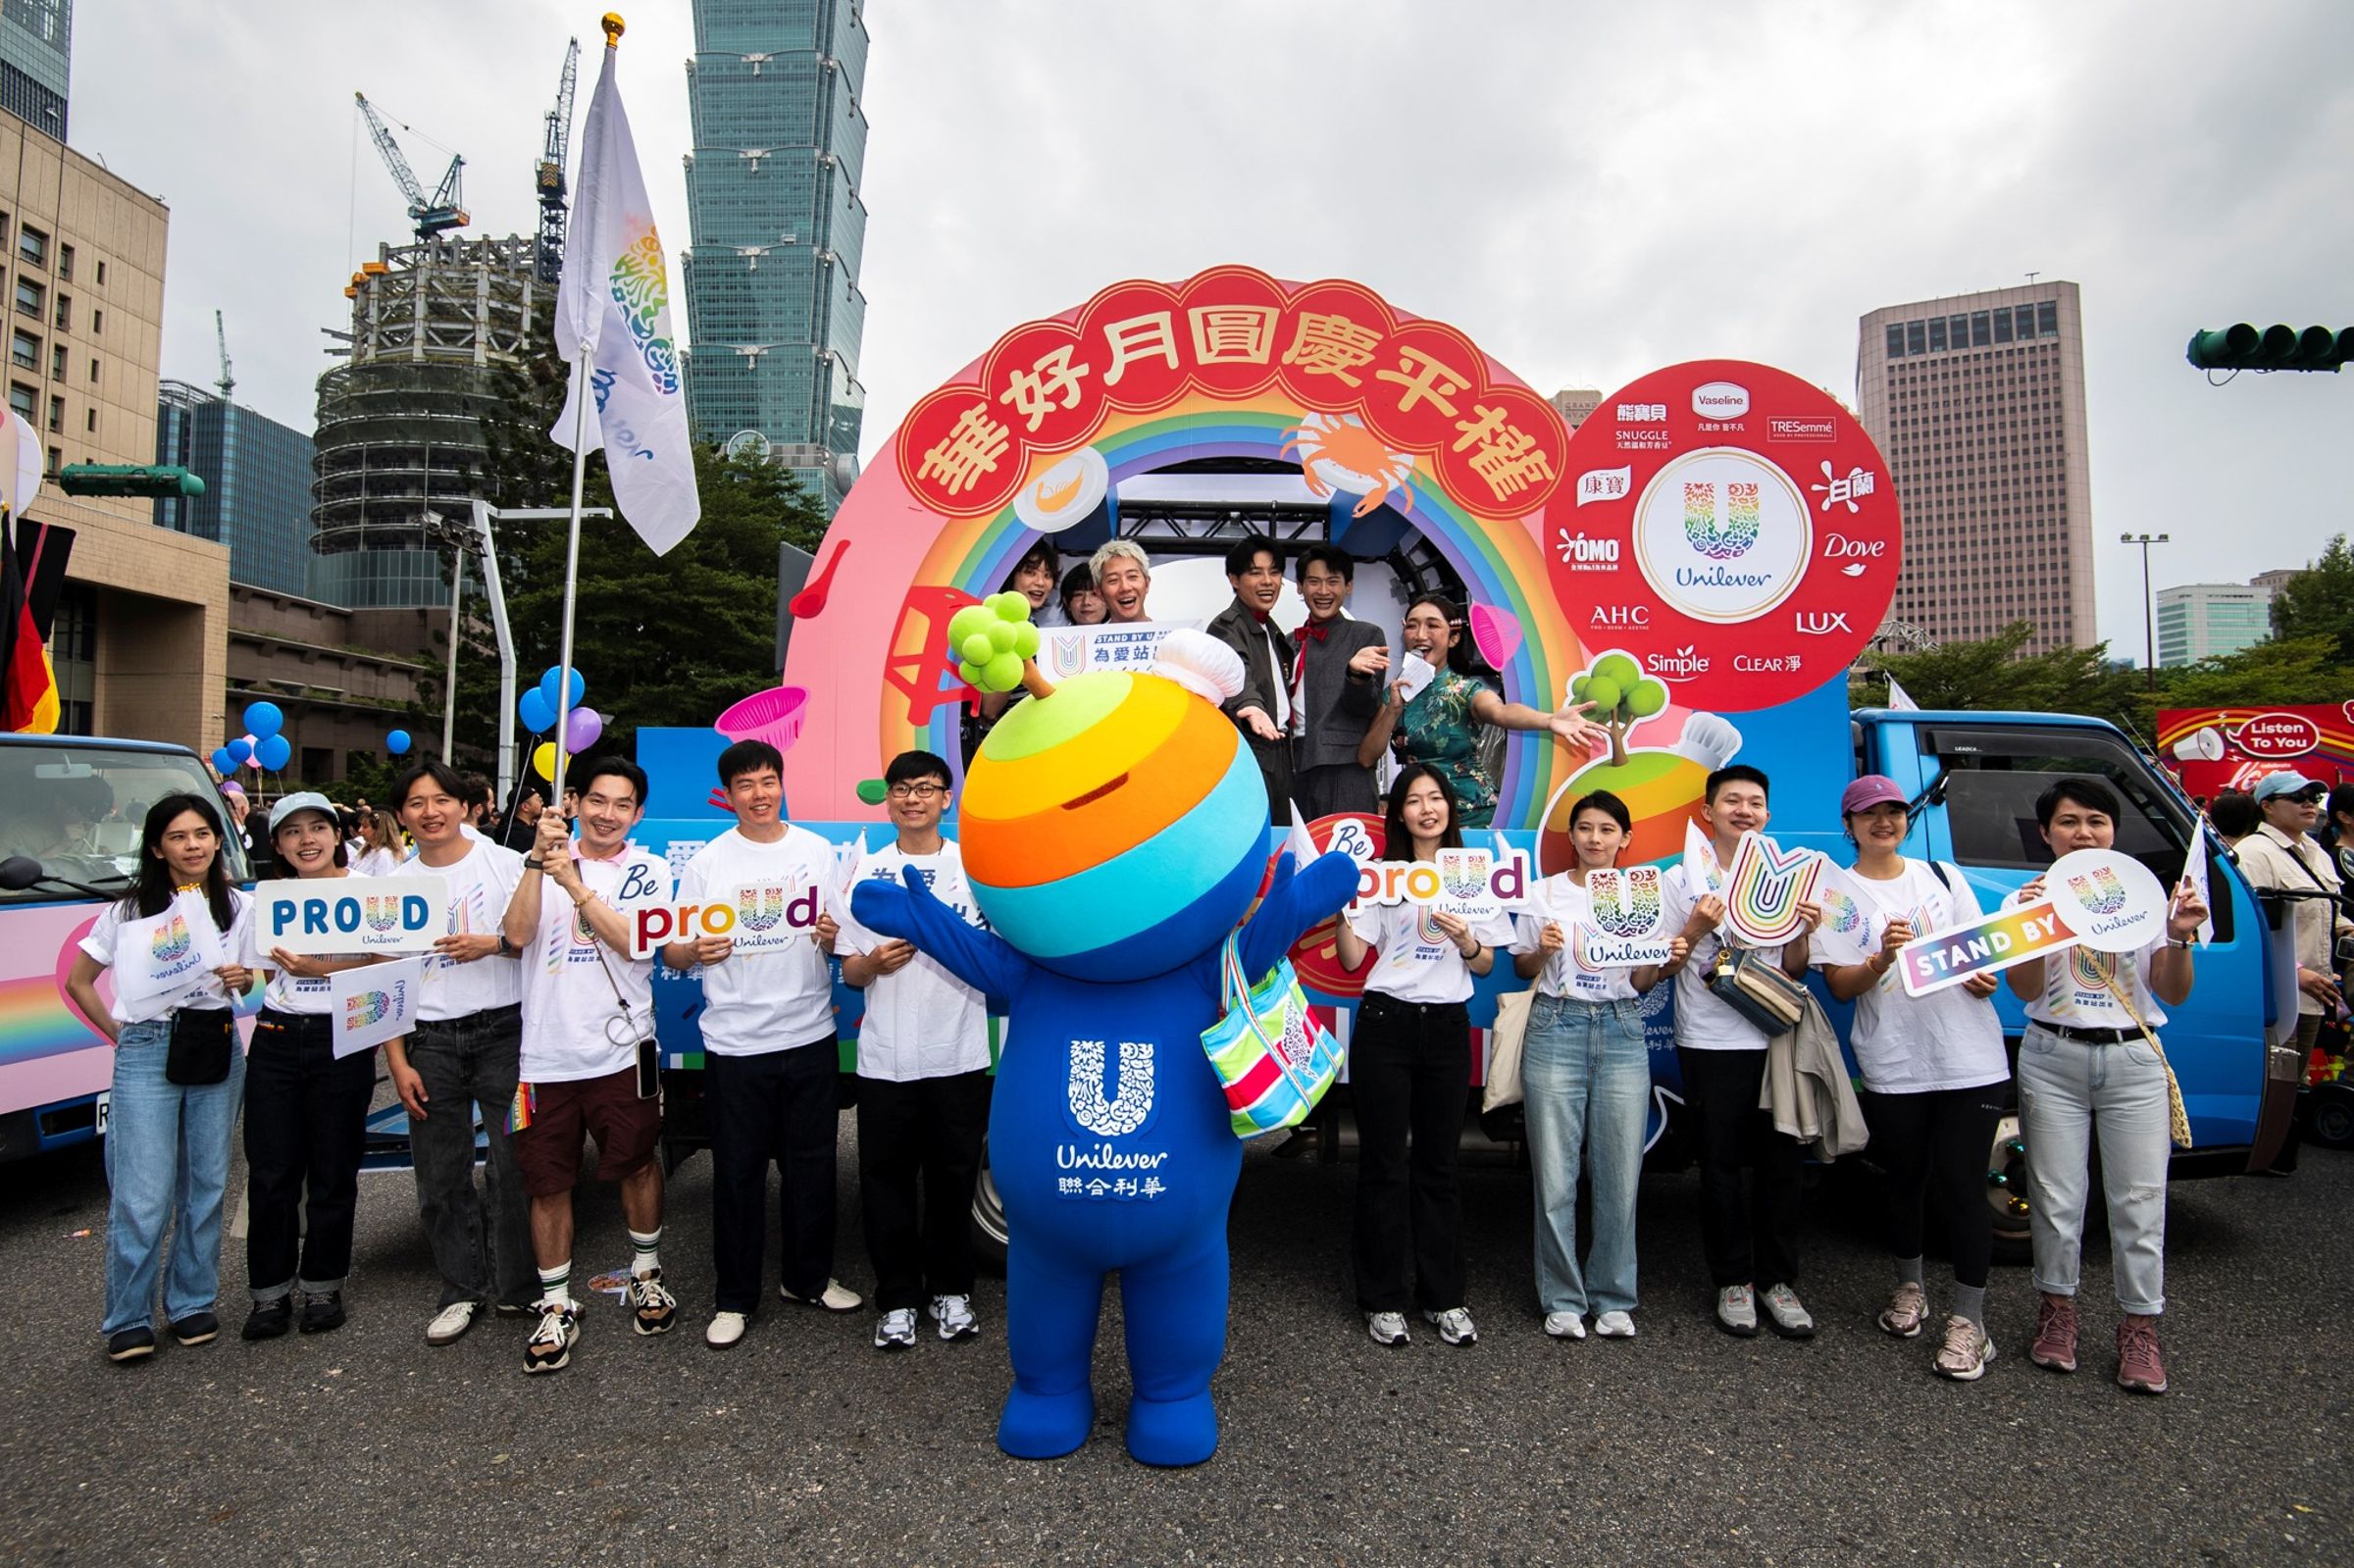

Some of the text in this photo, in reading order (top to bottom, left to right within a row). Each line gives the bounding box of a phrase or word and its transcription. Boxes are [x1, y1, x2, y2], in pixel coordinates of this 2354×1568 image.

[1698, 395, 1744, 406] Vaseline
[1616, 404, 1667, 422] 熊寶貝
[1615, 430, 1668, 440] SNUGGLE
[1770, 421, 1833, 432] TRESemmé
[1584, 476, 1624, 494] 康寶
[1574, 538, 1619, 562] OMO
[1824, 532, 1885, 557] Dove
[1675, 566, 1772, 587] Unilever
[1590, 605, 1649, 624] AHC
[1796, 612, 1853, 634] LUX
[1096, 633, 1128, 643] STAND
[1131, 632, 1144, 642] BY
[1094, 644, 1157, 663] 為愛站
[1647, 647, 1710, 677] Simple
[2250, 723, 2304, 734] Listen
[2250, 737, 2307, 748] To You
[1334, 825, 1368, 856] Be
[618, 863, 659, 901] Be
[272, 894, 430, 936] PROUD
[2090, 910, 2148, 936] Unilever
[362, 934, 403, 945] Unilever
[733, 935, 789, 948] Unilever
[1916, 912, 2056, 977] STAND BY
[1056, 1142, 1168, 1170] Unilever
[1057, 1176, 1167, 1198] 聯合利華
